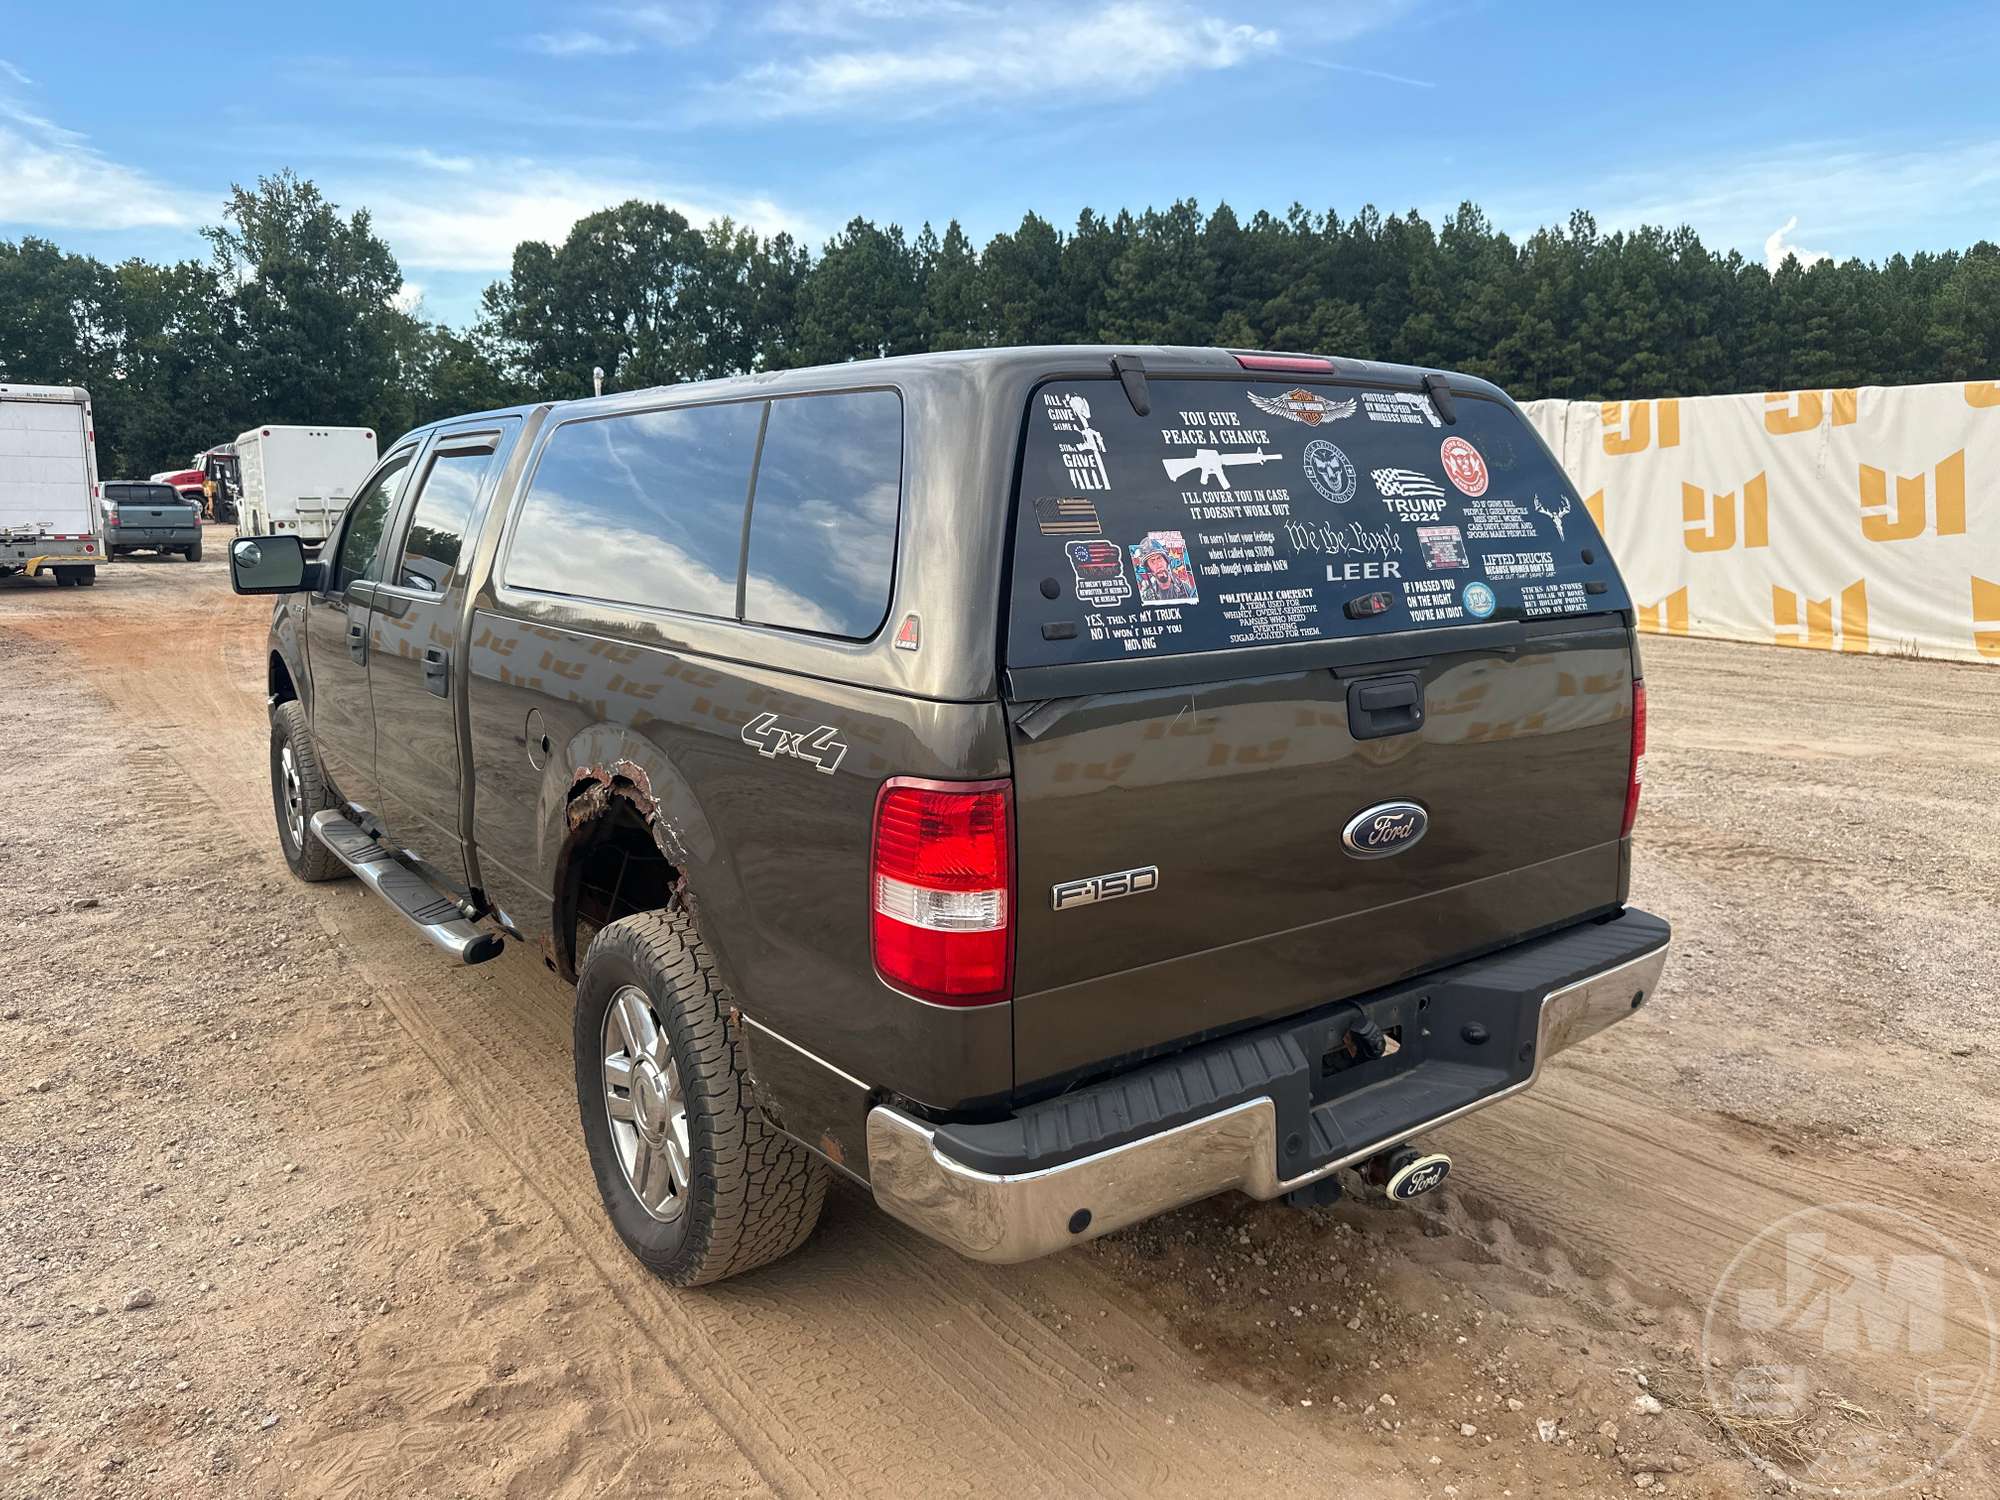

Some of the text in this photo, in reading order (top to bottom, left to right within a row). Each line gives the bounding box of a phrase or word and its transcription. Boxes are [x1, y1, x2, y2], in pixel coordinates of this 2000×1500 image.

[1048, 408, 1075, 421] GAVE
[1179, 411, 1240, 426] YOU GIVE
[1053, 423, 1073, 431] SOME
[1161, 429, 1270, 444] PEACE A CHANCE
[1063, 454, 1097, 468] GAVE
[1181, 489, 1290, 504] I'LL COVER YOU IN CASE
[1190, 503, 1290, 519] IT DOESN'T WORK OUT
[1383, 499, 1447, 512] TRUMP
[1400, 513, 1440, 522] 2024
[1284, 519, 1320, 554] We
[1347, 521, 1403, 560] People
[1481, 552, 1553, 566] LIFTED TRUCKS
[1326, 561, 1401, 582] LEER
[1402, 579, 1456, 593] IF I PASSED YOU
[1521, 582, 1582, 594] STICKS AND STONES
[1219, 588, 1313, 604] POLITICALLY CORRECT
[1407, 593, 1452, 607] ON THE RIGHT
[1564, 596, 1587, 604] POINTS
[1246, 601, 1266, 610] TERM
[1267, 600, 1285, 608] USED
[1285, 599, 1300, 607] FOR
[1526, 607, 1551, 616] EXPAND
[1084, 608, 1182, 627] YES, THIS IS MY TRUCK
[1268, 615, 1287, 624] WHO
[1287, 614, 1306, 622] NEED
[1409, 606, 1464, 622] YOU'RE AN IDIOT
[1090, 624, 1182, 640] NO I WON'T HELP YOU
[1252, 622, 1297, 633] EVERYTHING
[1285, 629, 1300, 638] FOR
[1124, 637, 1157, 651] MOVING
[1368, 813, 1414, 845] Ford
[1407, 1166, 1441, 1195] Ford
